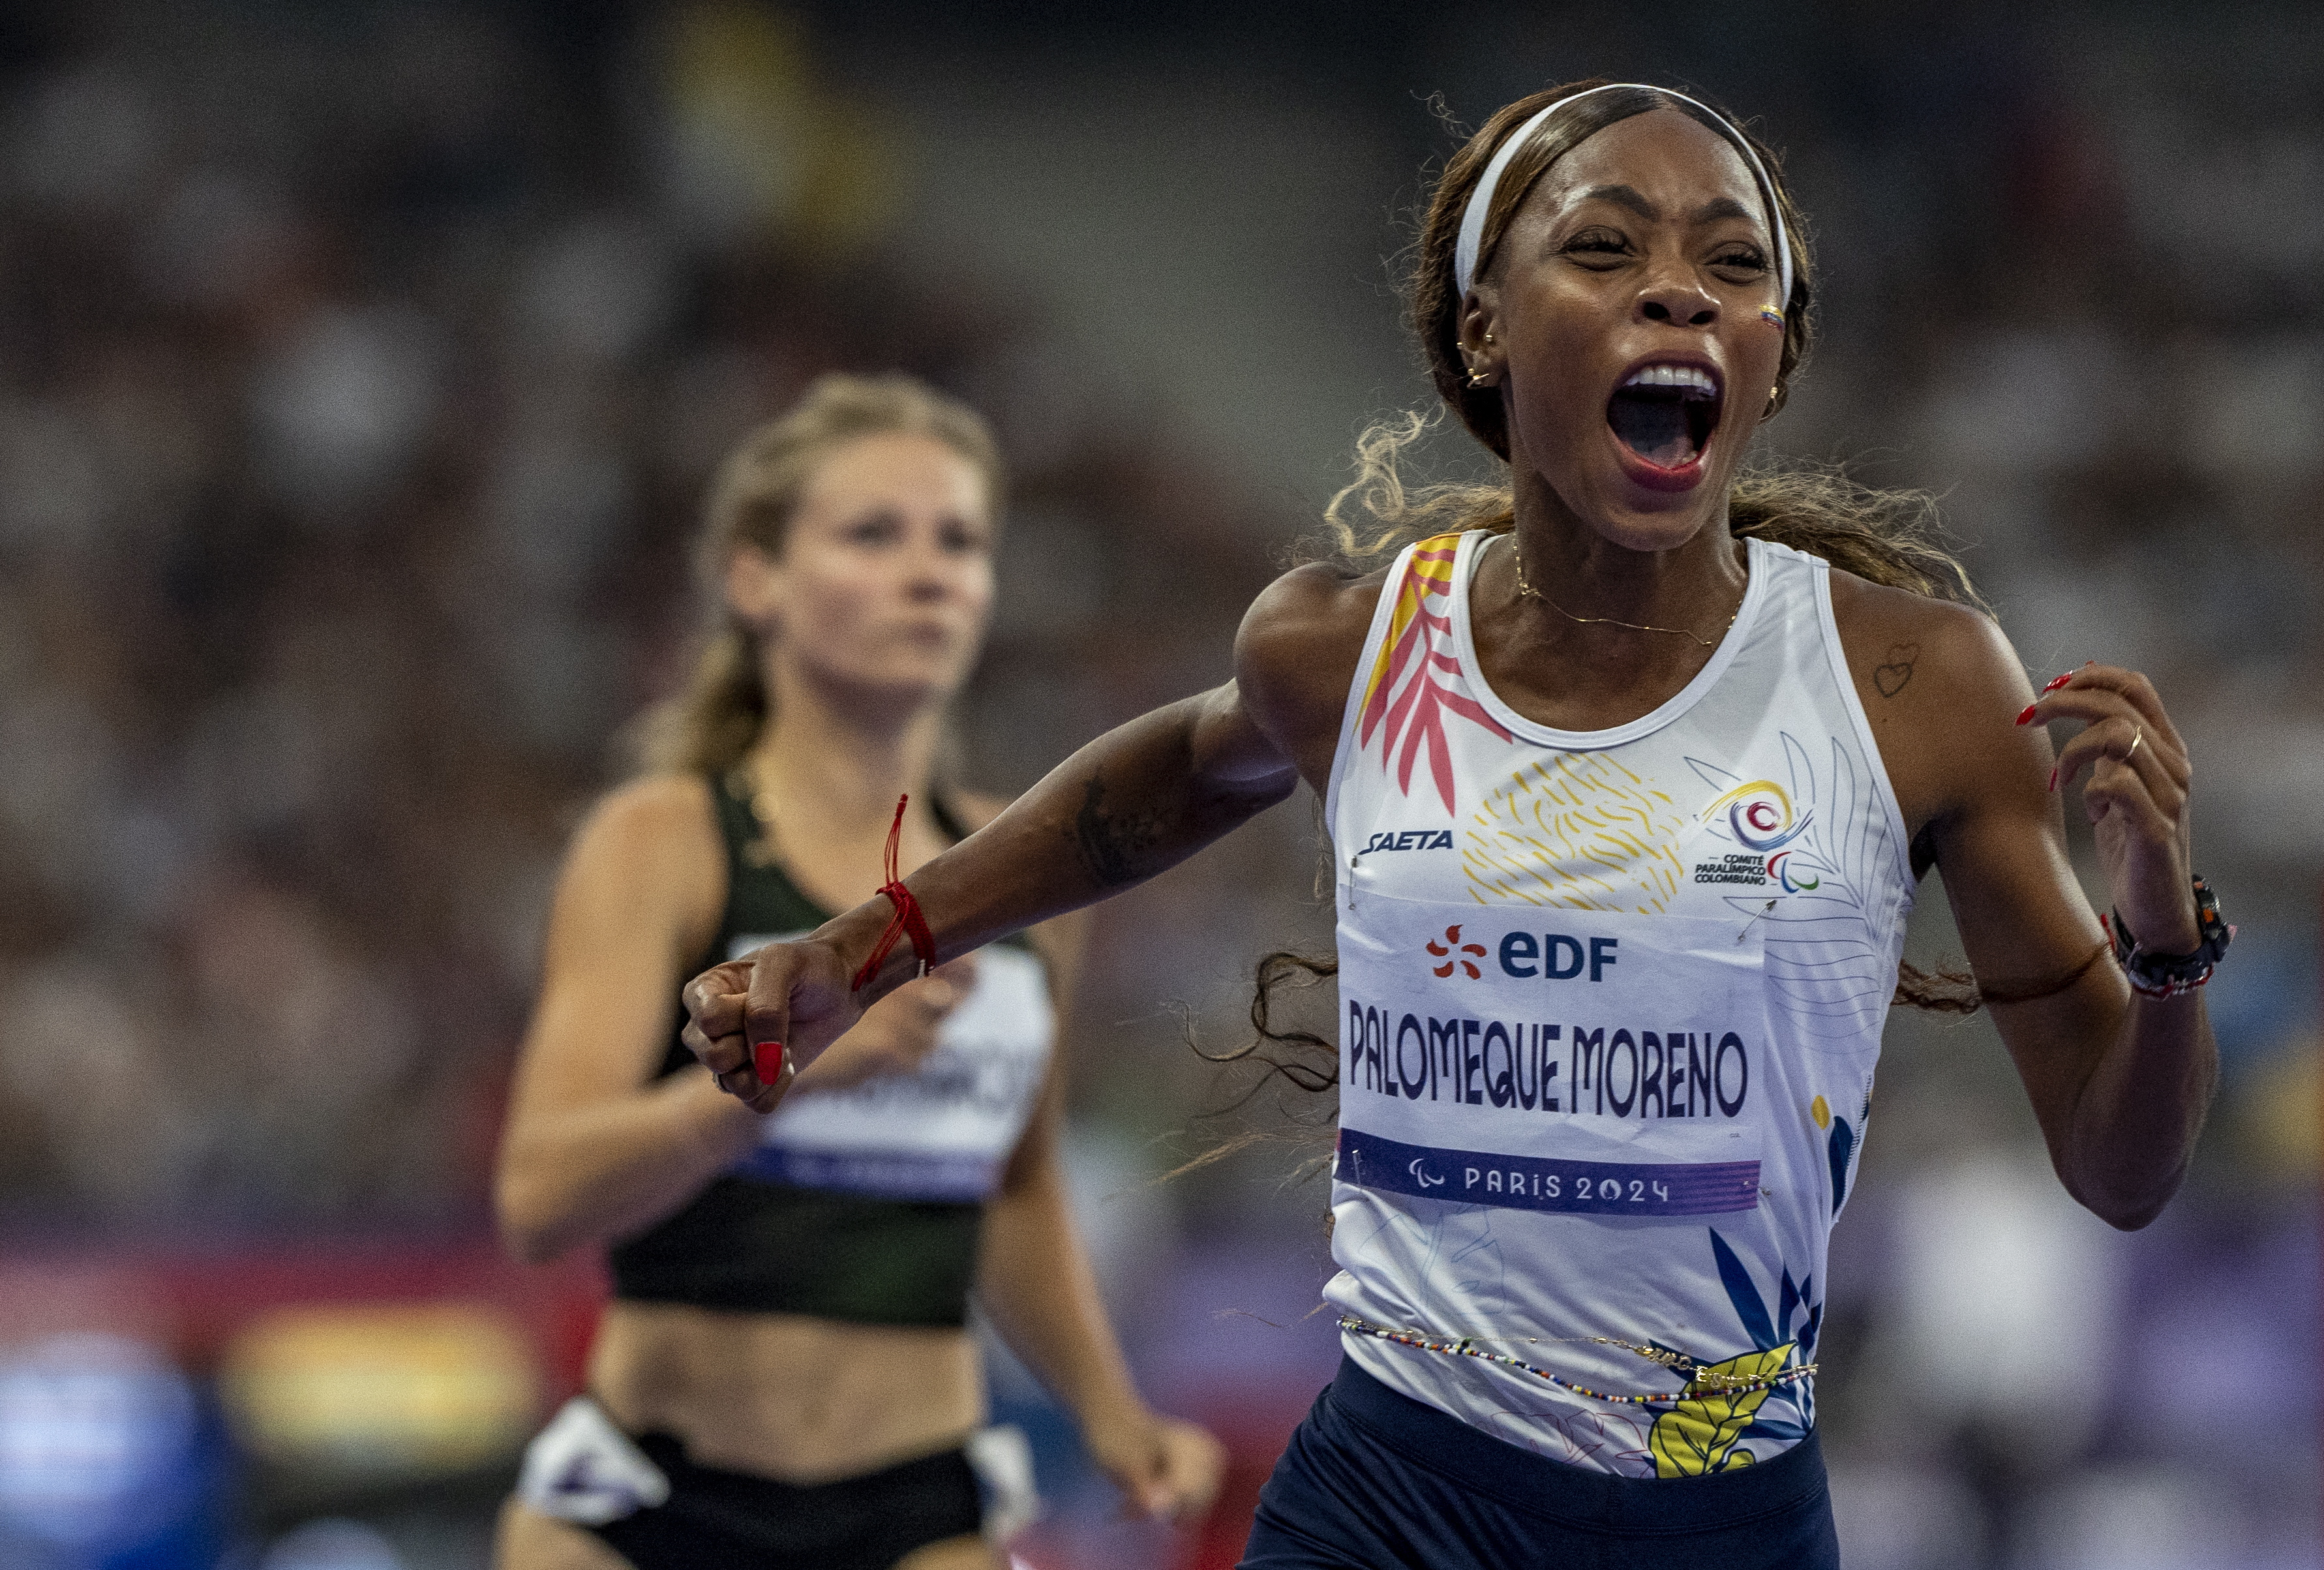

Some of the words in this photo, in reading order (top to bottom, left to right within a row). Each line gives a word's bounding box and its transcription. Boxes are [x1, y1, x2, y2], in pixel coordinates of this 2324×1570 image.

[1358, 830, 1453, 855] SAETA
[1696, 862, 1766, 875] PARALÍMPICO
[1724, 854, 1764, 866] COMITÉ
[1695, 874, 1766, 885] COLOMBIANO
[1350, 999, 1562, 1113] PALOMEQUE
[1571, 1025, 1748, 1118] MORENO
[1576, 1177, 1668, 1202] 2024
